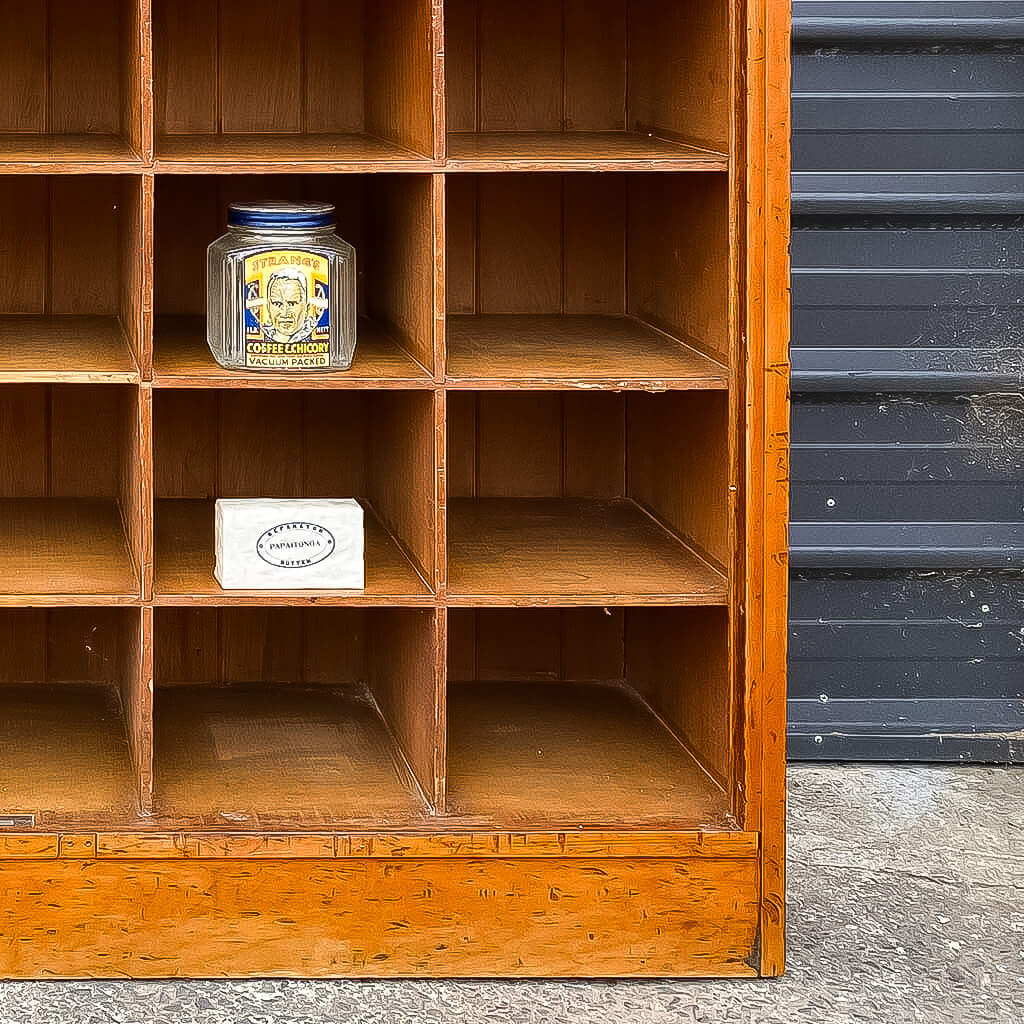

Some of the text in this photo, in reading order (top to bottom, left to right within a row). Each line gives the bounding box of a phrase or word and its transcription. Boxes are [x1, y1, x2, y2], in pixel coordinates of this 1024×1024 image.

[246, 342, 284, 354] COFFEE
[291, 342, 330, 354] CHICORY
[248, 357, 289, 366] VACUUM
[291, 356, 326, 366] PACKED
